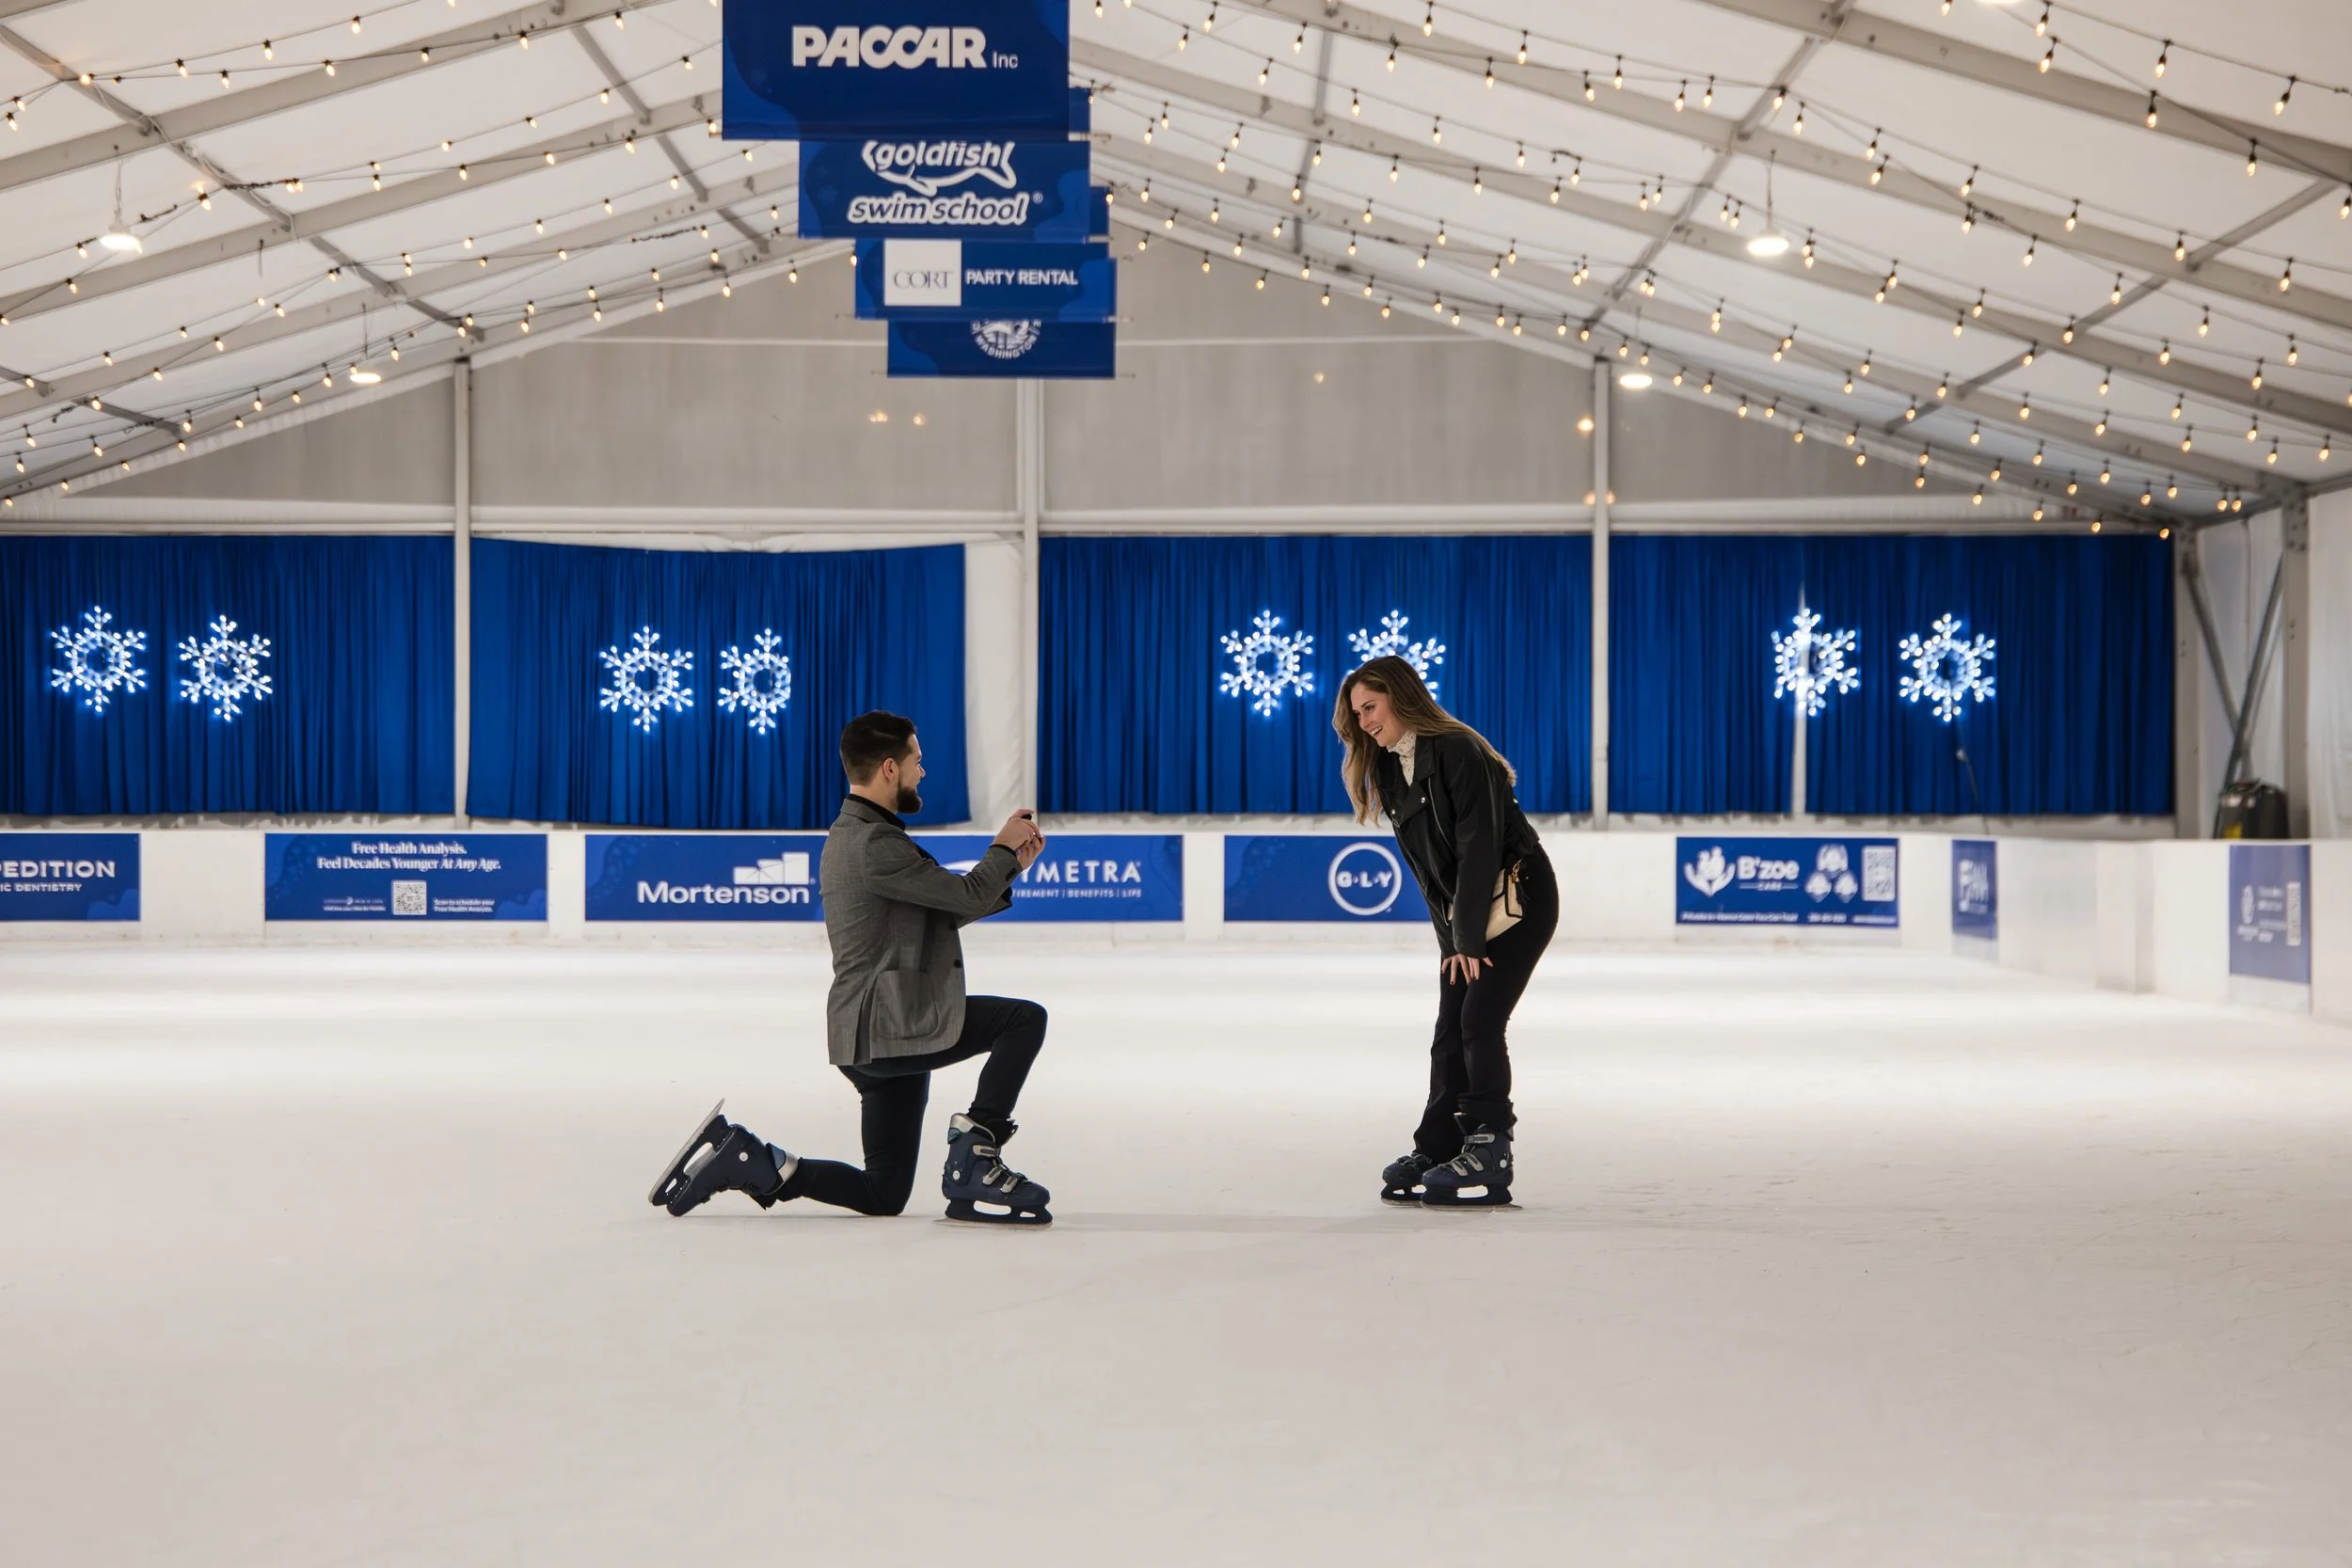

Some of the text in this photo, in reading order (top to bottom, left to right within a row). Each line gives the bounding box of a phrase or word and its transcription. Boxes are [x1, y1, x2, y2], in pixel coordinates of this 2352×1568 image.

[792, 24, 1019, 70] PACCAR Inc
[875, 141, 1003, 171] goldfish
[848, 191, 1031, 226] swim school
[893, 268, 1079, 289] CORT PARTY RENTAL
[975, 334, 1037, 359] WASHINGTON
[352, 841, 468, 857] Free Health Analysis.
[0, 860, 115, 878] EDITION
[317, 857, 342, 869] Feel
[342, 857, 390, 869] Decades
[392, 857, 439, 872] Younger
[440, 858, 453, 869] At
[454, 858, 477, 871] Any
[1737, 855, 1800, 880] B'zoe
[14, 883, 83, 892] DENTISTRY
[637, 880, 810, 904] Mortenson
[1068, 889, 1114, 898] BENEFITS
[1121, 889, 1142, 898] LIFE
